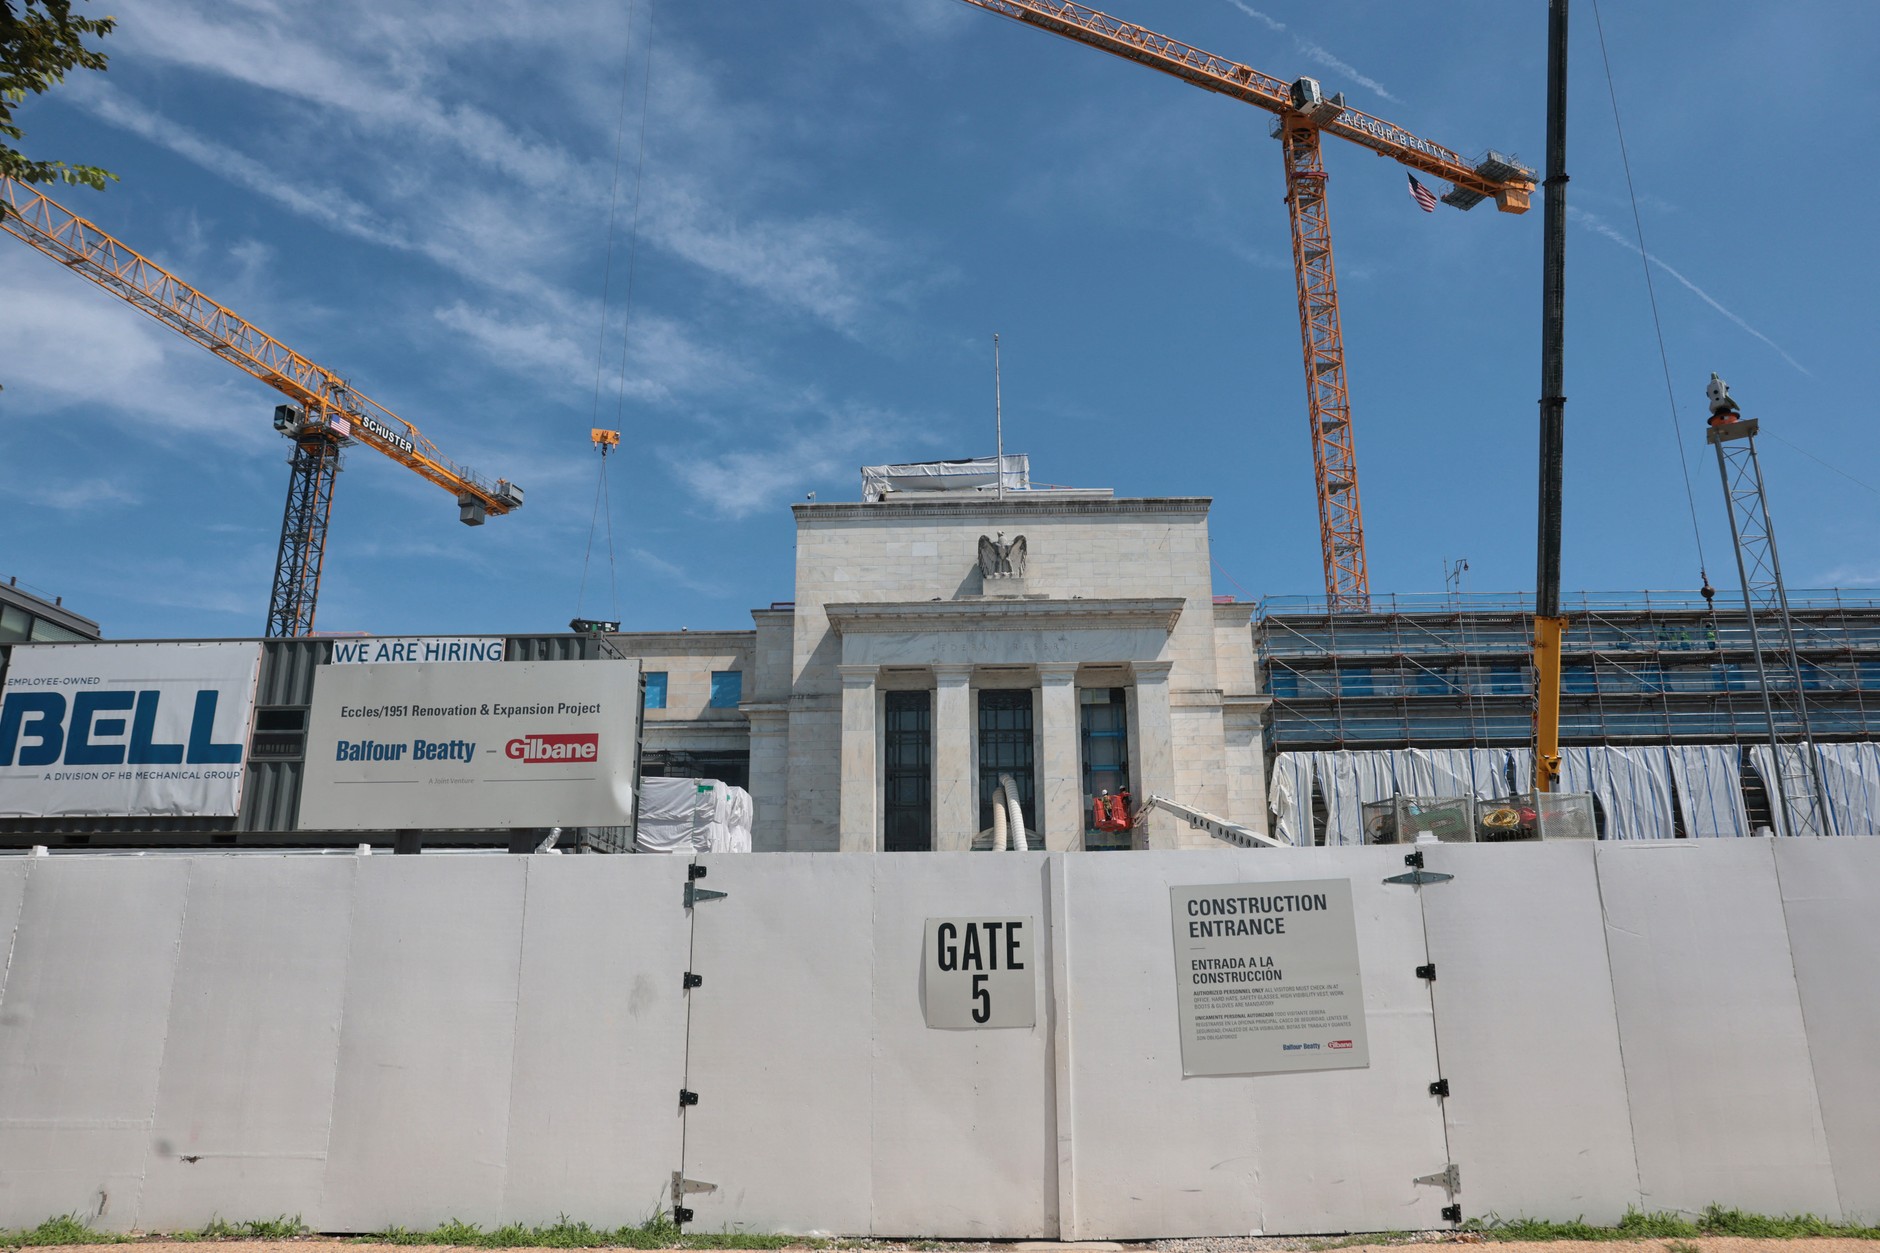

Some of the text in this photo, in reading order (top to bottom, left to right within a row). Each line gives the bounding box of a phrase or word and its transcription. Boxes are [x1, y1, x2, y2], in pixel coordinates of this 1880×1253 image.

[1400, 134, 1445, 158] BEATTY
[363, 416, 412, 453] SCHUSTER
[335, 642, 503, 663] WE ARE HIRING
[7, 677, 100, 686] EMPLOYEE-OWNED
[341, 702, 601, 718] Eccles/1951 Renovation & Expansion Project
[0, 690, 243, 766] BELL
[336, 738, 597, 763] Balfour Beatty Gilbane
[44, 771, 240, 780] A DIVISION OF HB MECHANICAL GROUP
[1187, 893, 1327, 917] CONSTRUCTION
[1189, 917, 1286, 938] ENTRANCE
[938, 922, 1024, 971] GATE
[1191, 956, 1274, 971] ENTRADA A LA
[1193, 967, 1282, 985] CONSTRUCCIÓN
[972, 974, 990, 1023] 5
